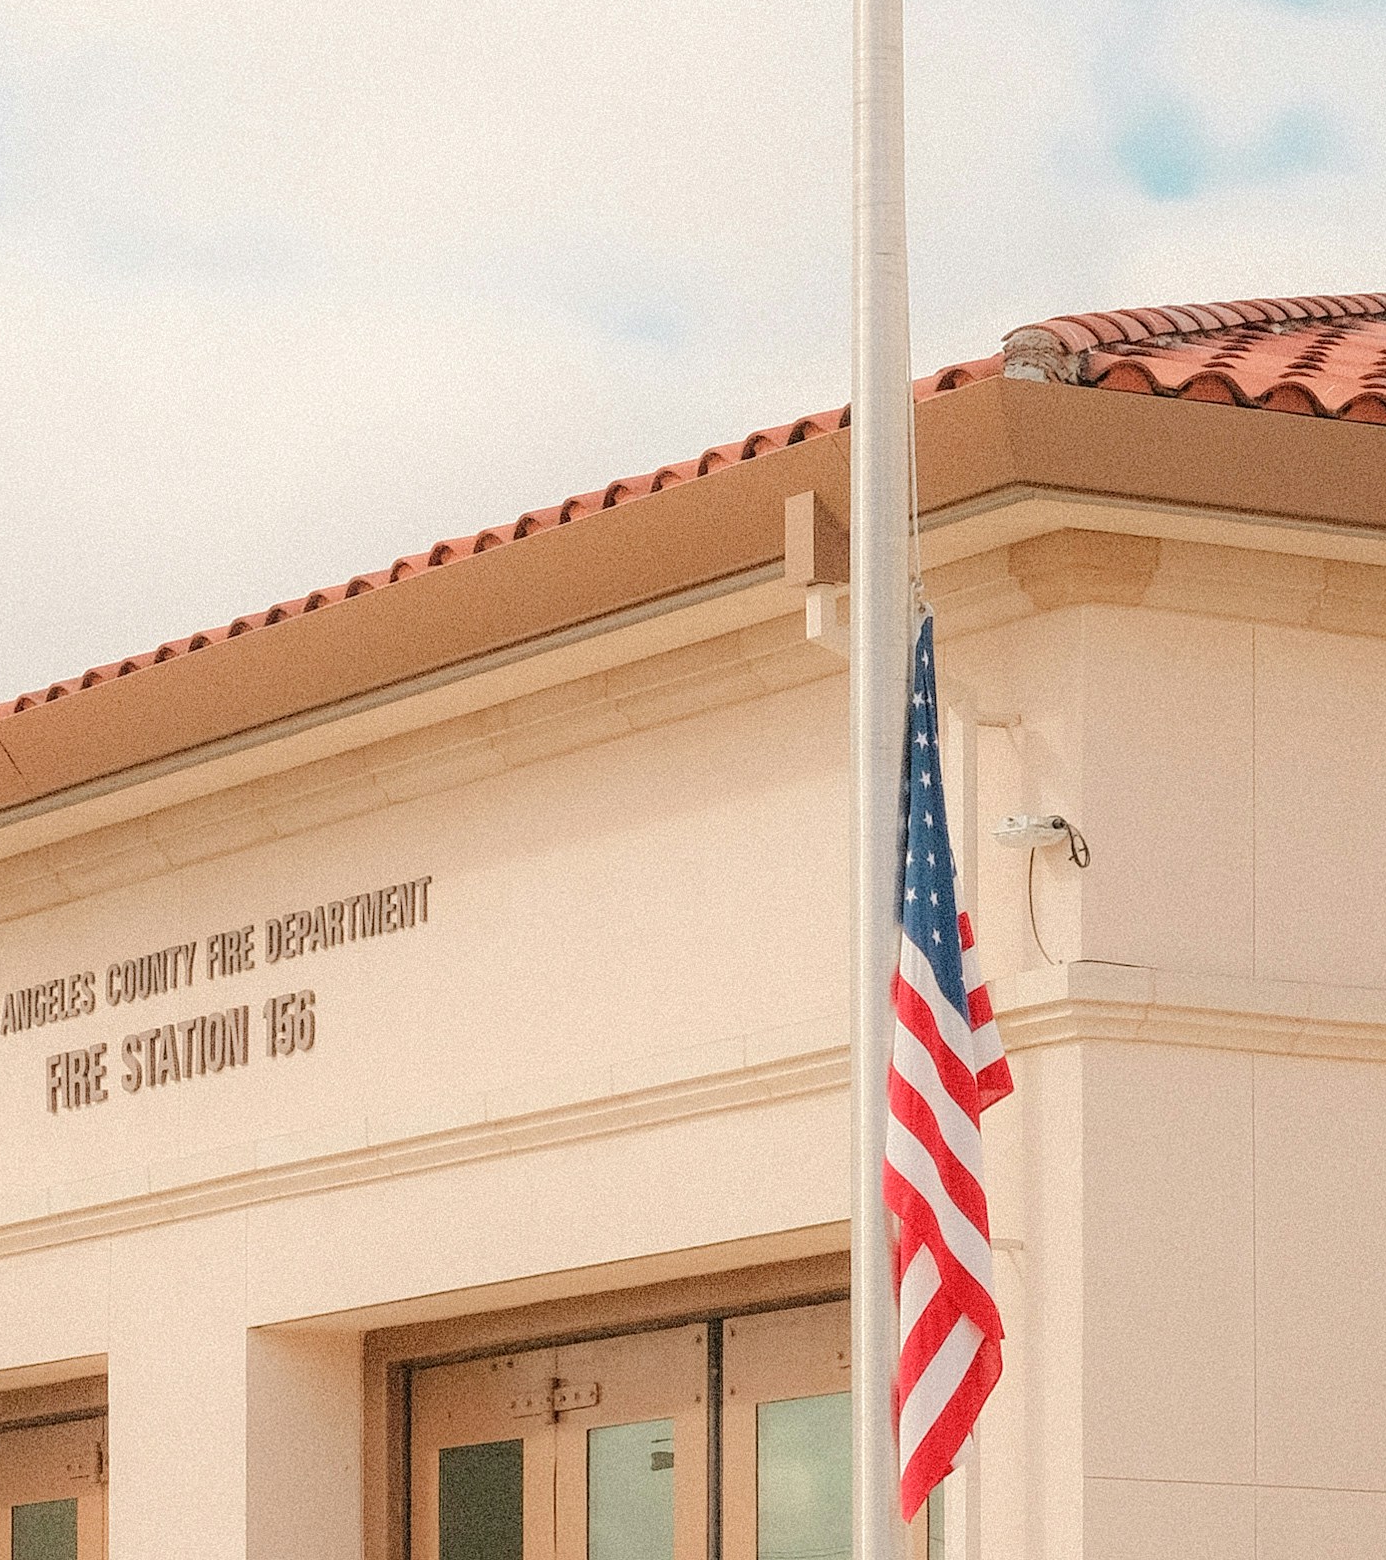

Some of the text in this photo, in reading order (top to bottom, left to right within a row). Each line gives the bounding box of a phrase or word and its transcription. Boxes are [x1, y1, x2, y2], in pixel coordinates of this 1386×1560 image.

[0, 971, 96, 1036] ANGELES
[105, 941, 197, 1007] COUNTY
[206, 924, 256, 980] FIRE
[265, 875, 432, 964] DEPARTMENT
[45, 989, 316, 1114] FIRE STATION 156
